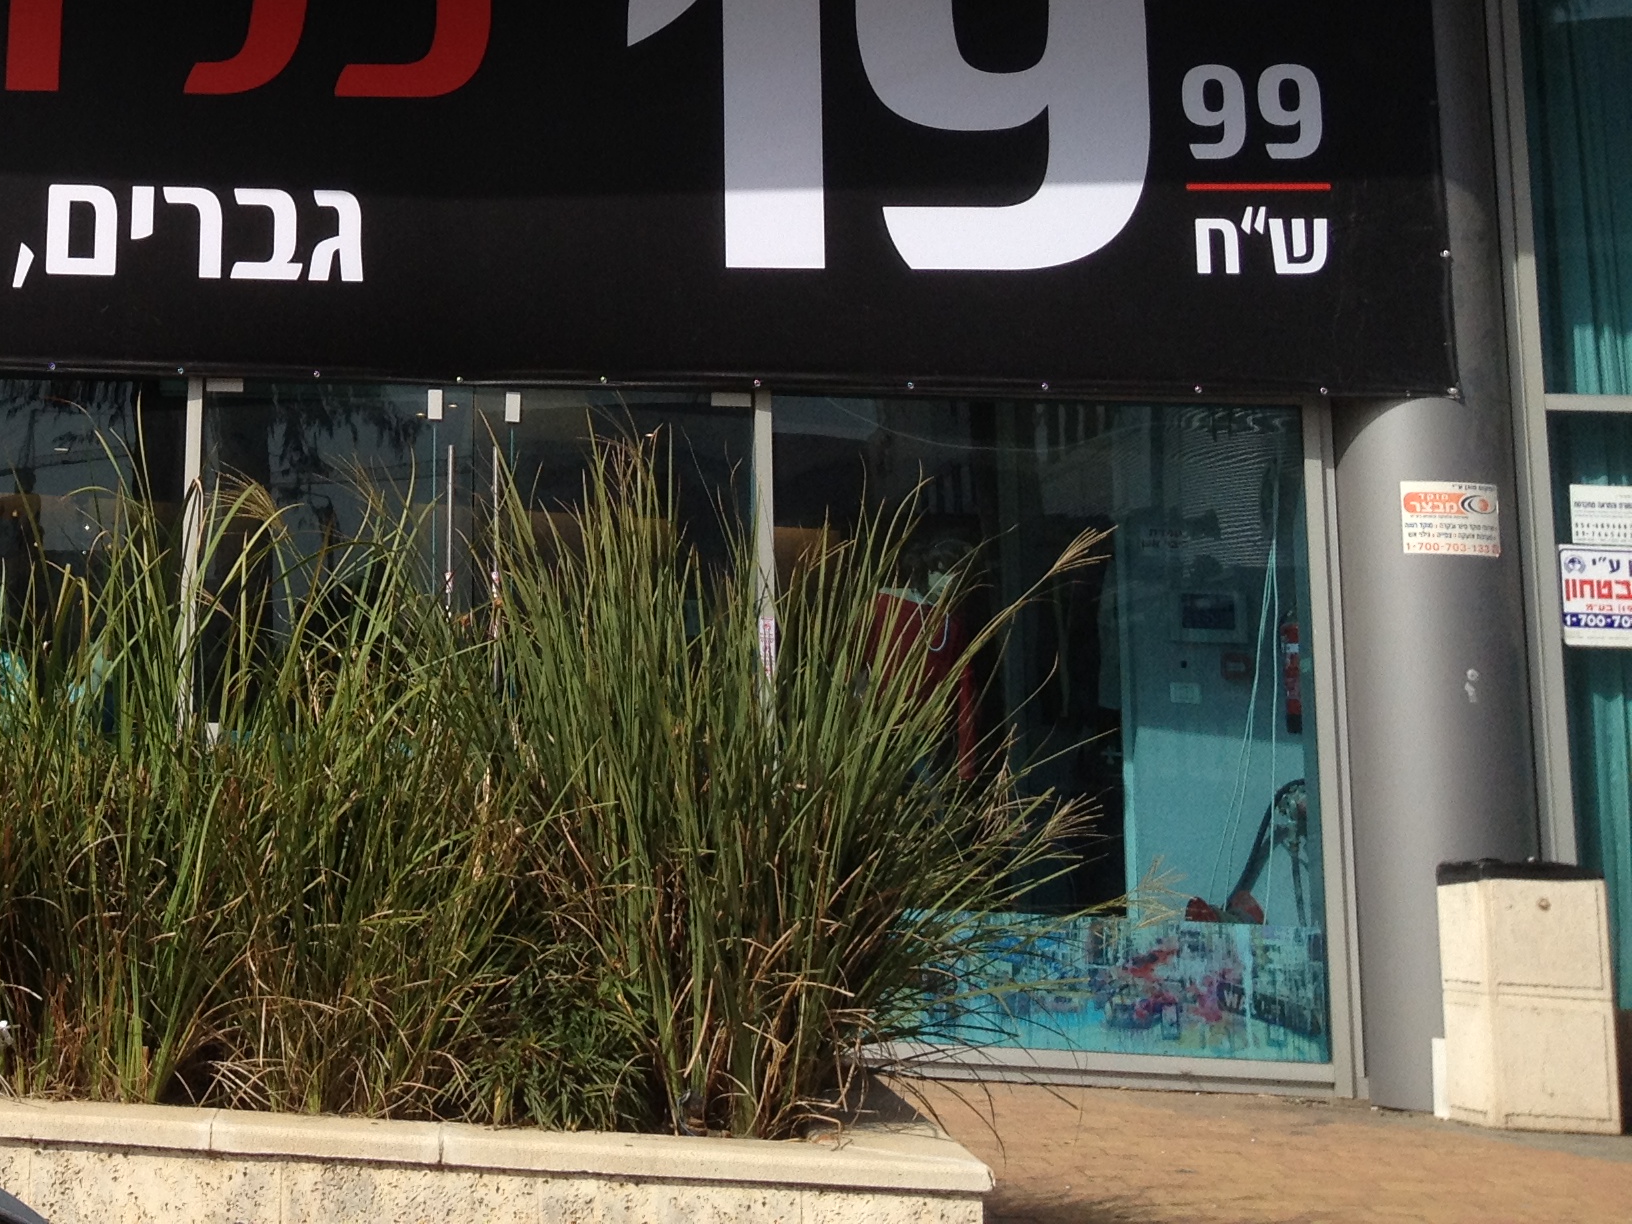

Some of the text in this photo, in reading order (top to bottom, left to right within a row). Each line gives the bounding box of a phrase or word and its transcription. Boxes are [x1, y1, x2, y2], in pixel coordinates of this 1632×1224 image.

[1181, 63, 1324, 160] 99
[13, 184, 364, 288] גברים,
[1418, 493, 1449, 501] מוקד
[1409, 501, 1458, 513] מבצר
[1565, 614, 1632, 628] 1-700-70
